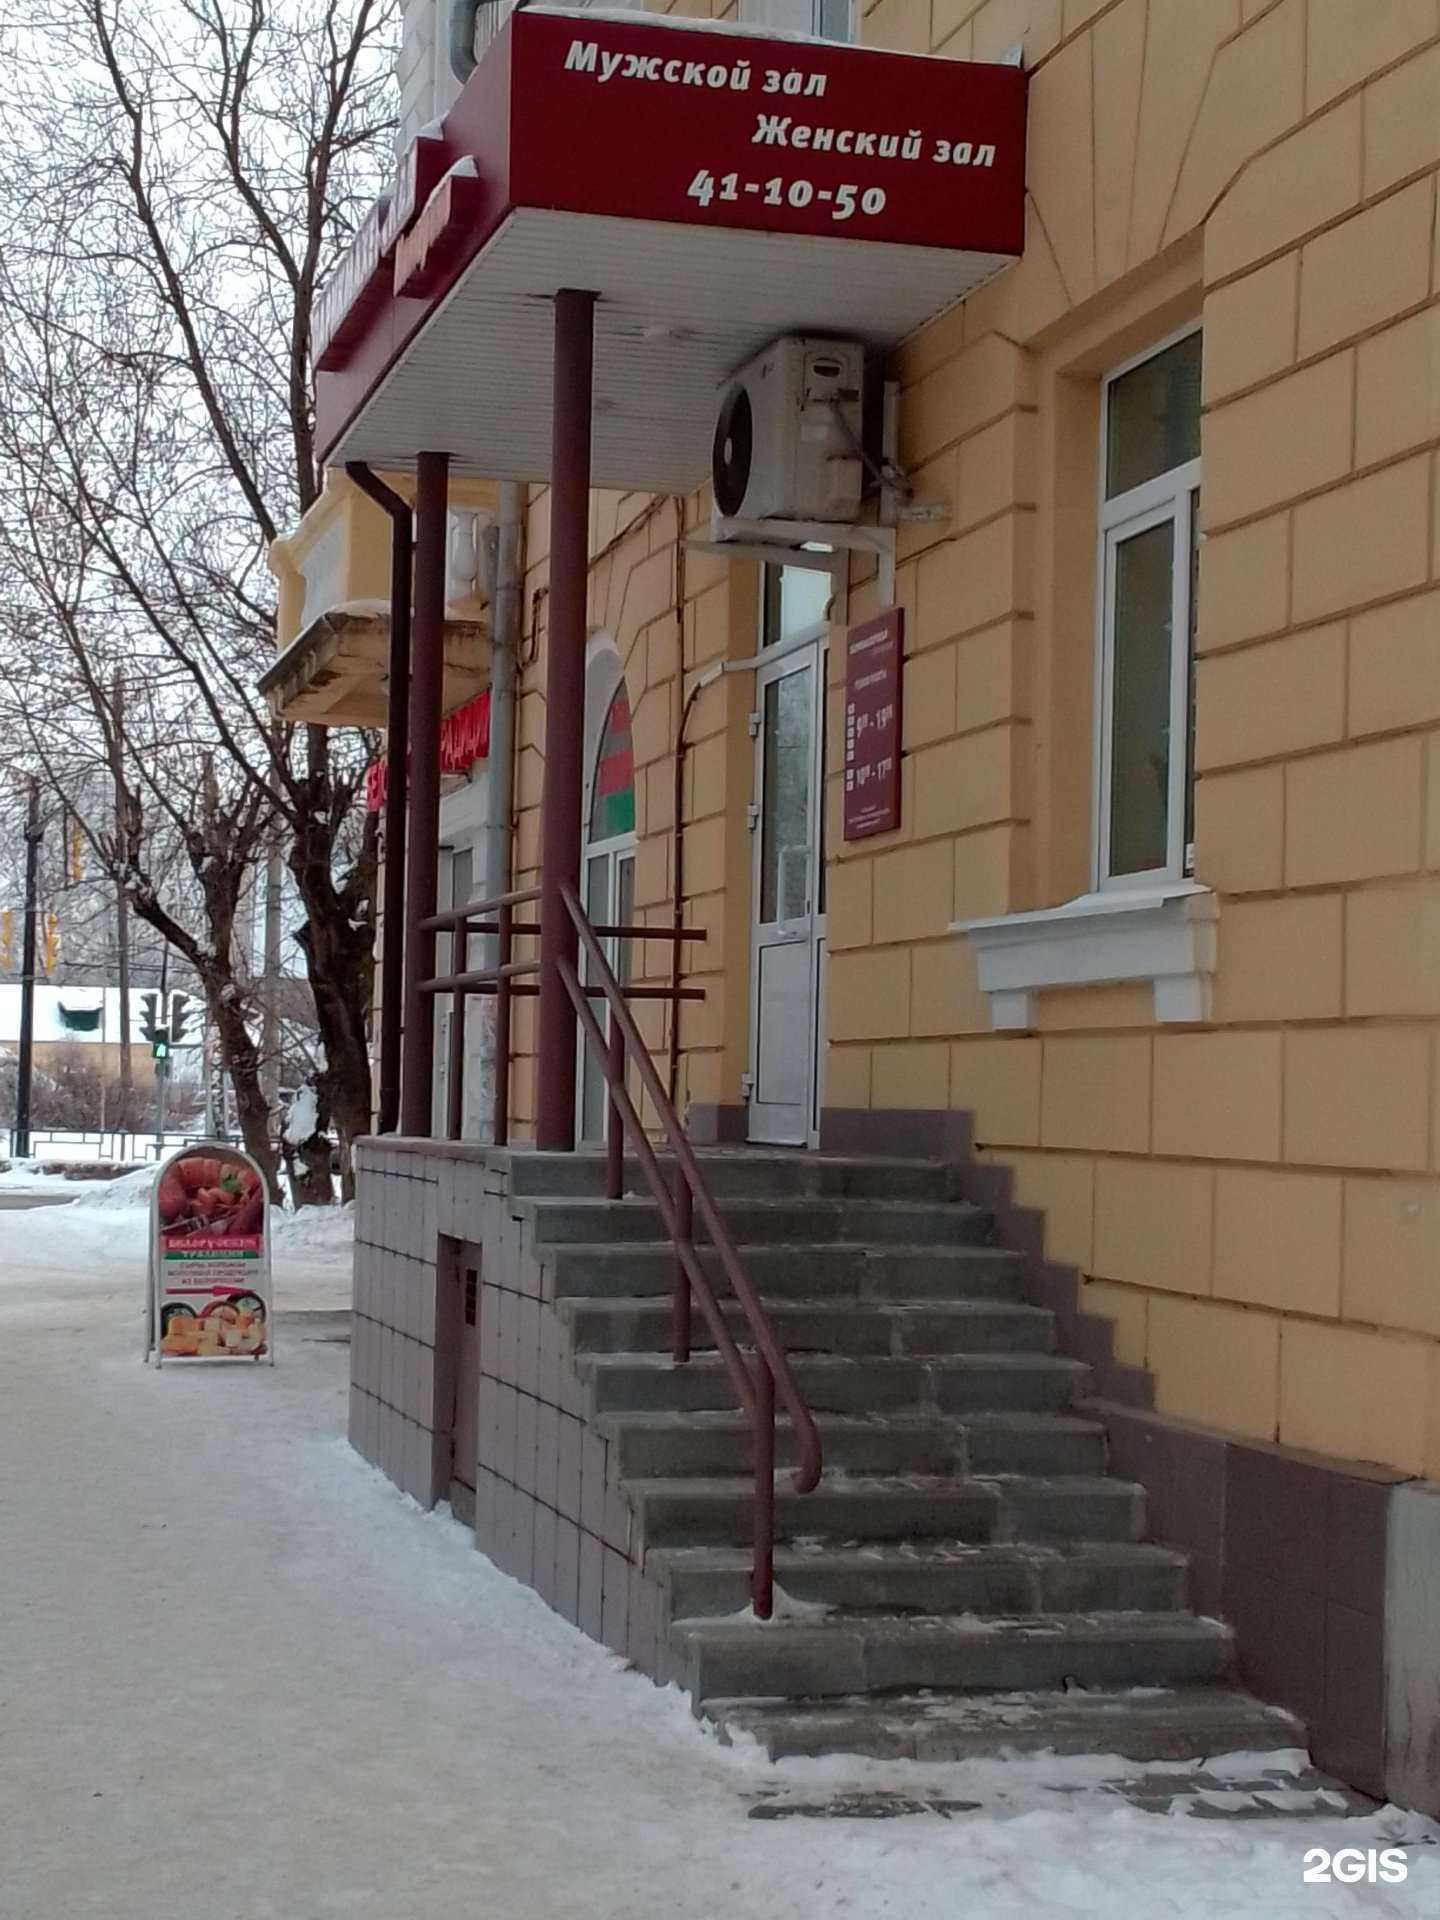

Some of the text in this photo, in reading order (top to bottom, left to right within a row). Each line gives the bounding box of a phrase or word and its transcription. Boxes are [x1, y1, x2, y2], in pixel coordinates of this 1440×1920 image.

[563, 40, 828, 97] Мужской зал
[752, 113, 997, 167] Женский зал
[687, 168, 887, 220] 41-10-50
